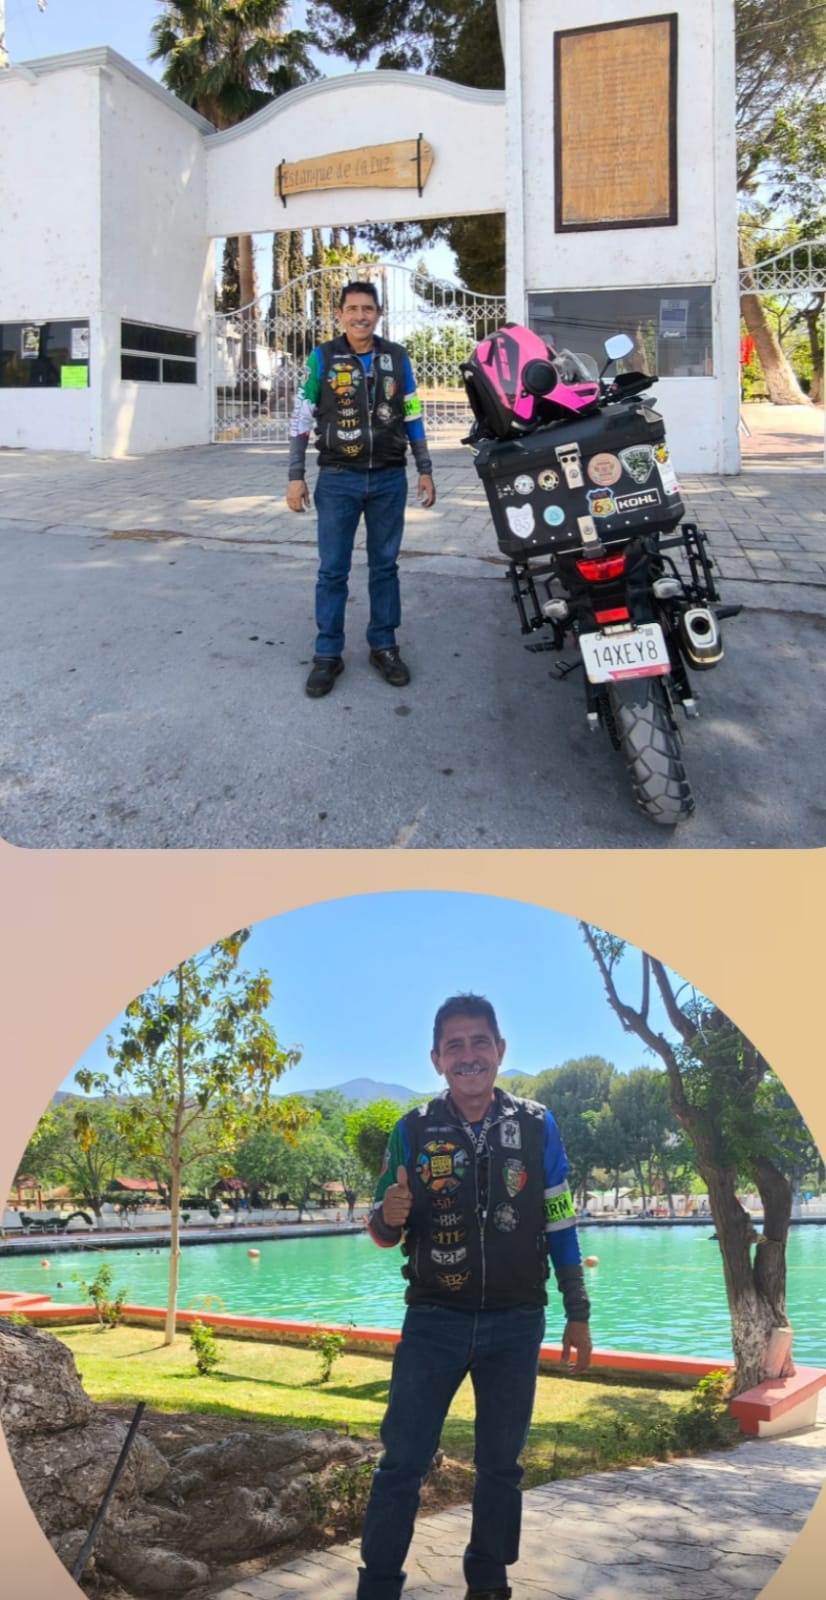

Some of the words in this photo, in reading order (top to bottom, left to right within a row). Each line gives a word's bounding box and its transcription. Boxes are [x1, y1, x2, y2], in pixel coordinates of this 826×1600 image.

[336, 161, 352, 179] de
[355, 159, 368, 177] la
[370, 156, 392, 174] Luz
[618, 494, 657, 510] KOHL
[593, 640, 658, 668] 14XEY8
